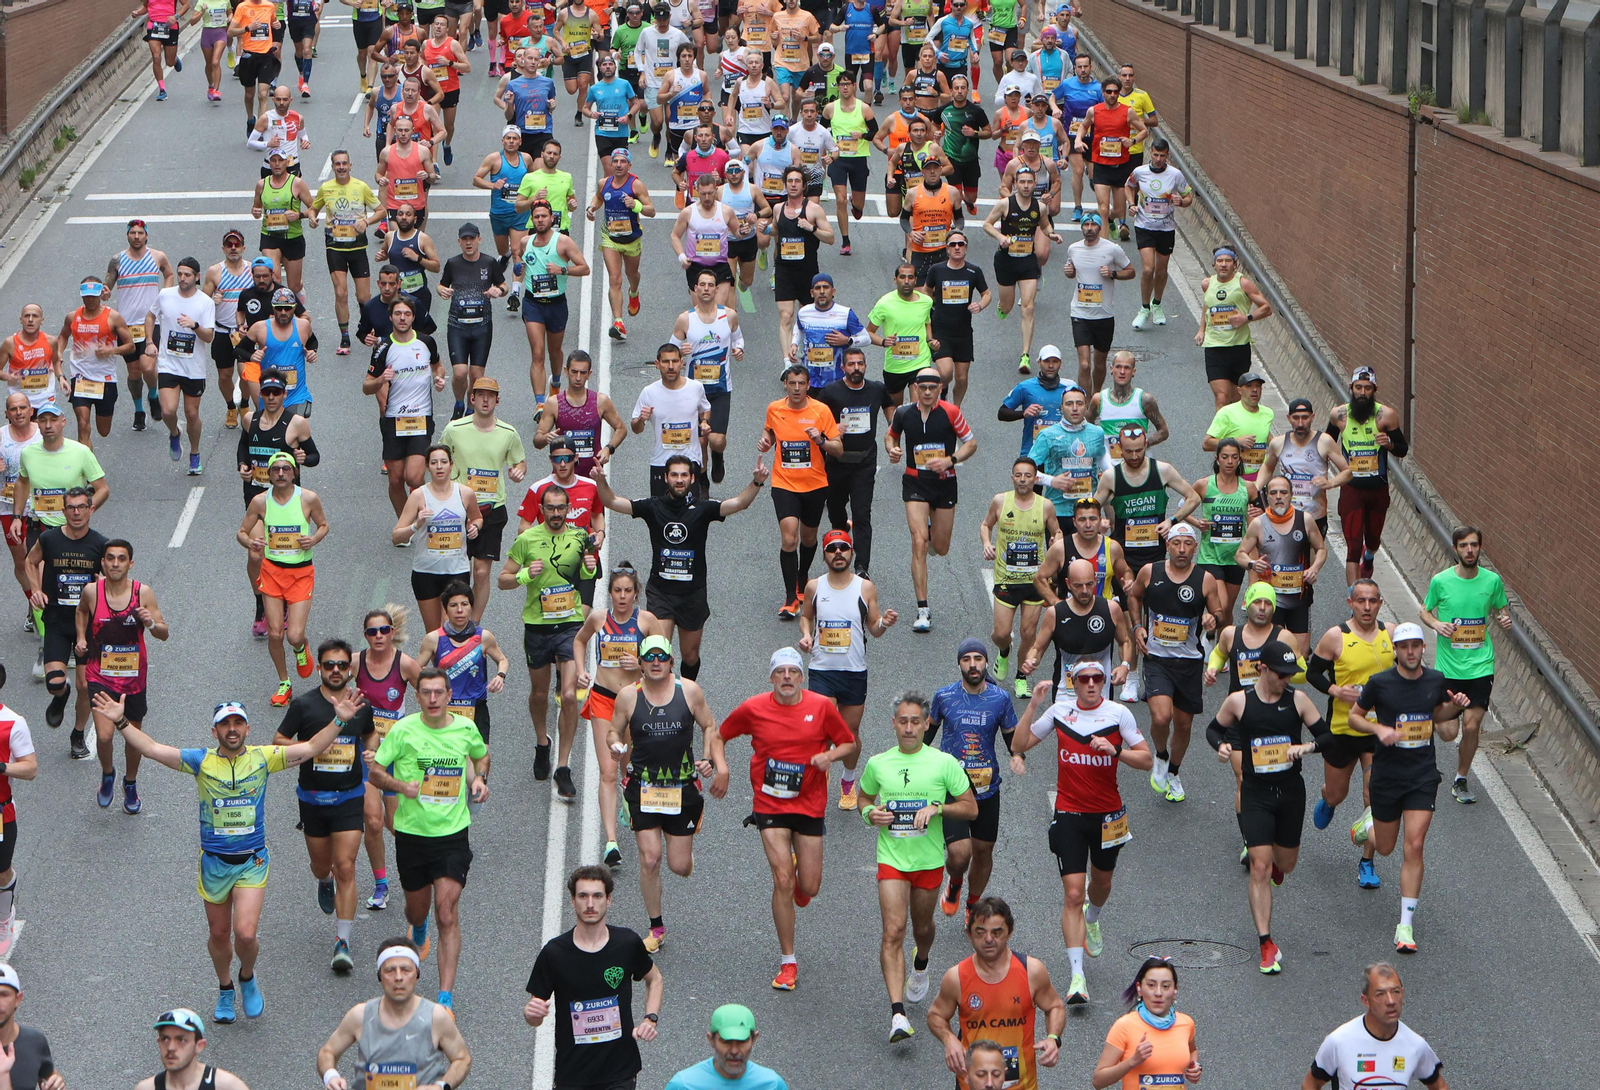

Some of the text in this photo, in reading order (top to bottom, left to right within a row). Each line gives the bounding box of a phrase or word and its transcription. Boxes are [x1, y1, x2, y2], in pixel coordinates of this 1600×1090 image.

[1124, 496, 1156, 507] VEGAN
[1125, 504, 1155, 514] RUNNERS
[552, 585, 571, 593] ZURICH
[1165, 616, 1185, 625] ZURICH
[374, 710, 395, 718] ZURICH
[432, 758, 458, 766] SIRIUS
[1060, 749, 1112, 766] Canon
[777, 763, 800, 771] ZURICH
[586, 1000, 612, 1009] ZURICH
[990, 1016, 1027, 1029] CAMAS
[585, 1025, 611, 1034] CORENTIN
